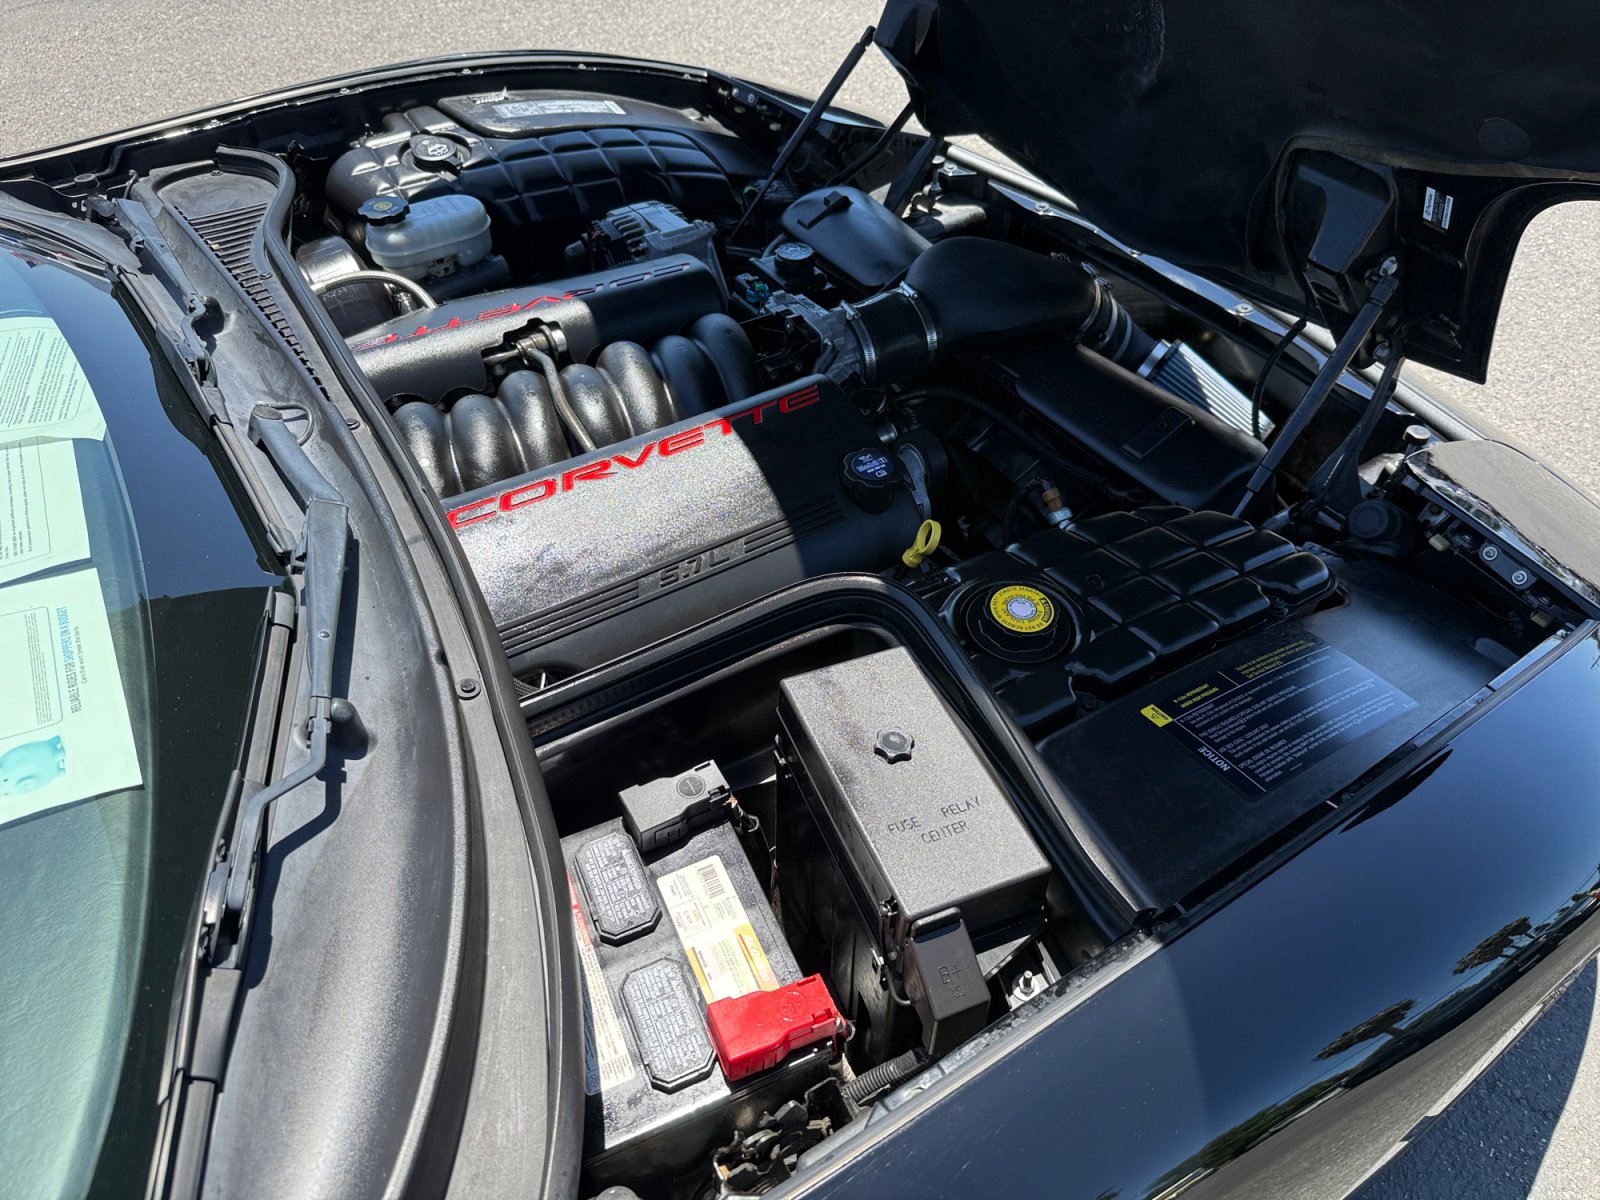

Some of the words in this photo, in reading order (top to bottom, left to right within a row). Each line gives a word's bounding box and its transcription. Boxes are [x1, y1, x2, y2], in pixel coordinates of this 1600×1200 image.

[354, 262, 690, 349] CORVETTE
[446, 385, 820, 529] CORVETTE
[659, 549, 730, 588] 5.7L
[56, 607, 68, 626] BUDGET
[68, 688, 82, 714] RELIABLE
[1198, 746, 1230, 771] NOTICE
[888, 816, 922, 834] FUSE
[940, 796, 980, 818] RELAY
[921, 820, 970, 844] CENTER
[938, 965, 962, 984] B+
